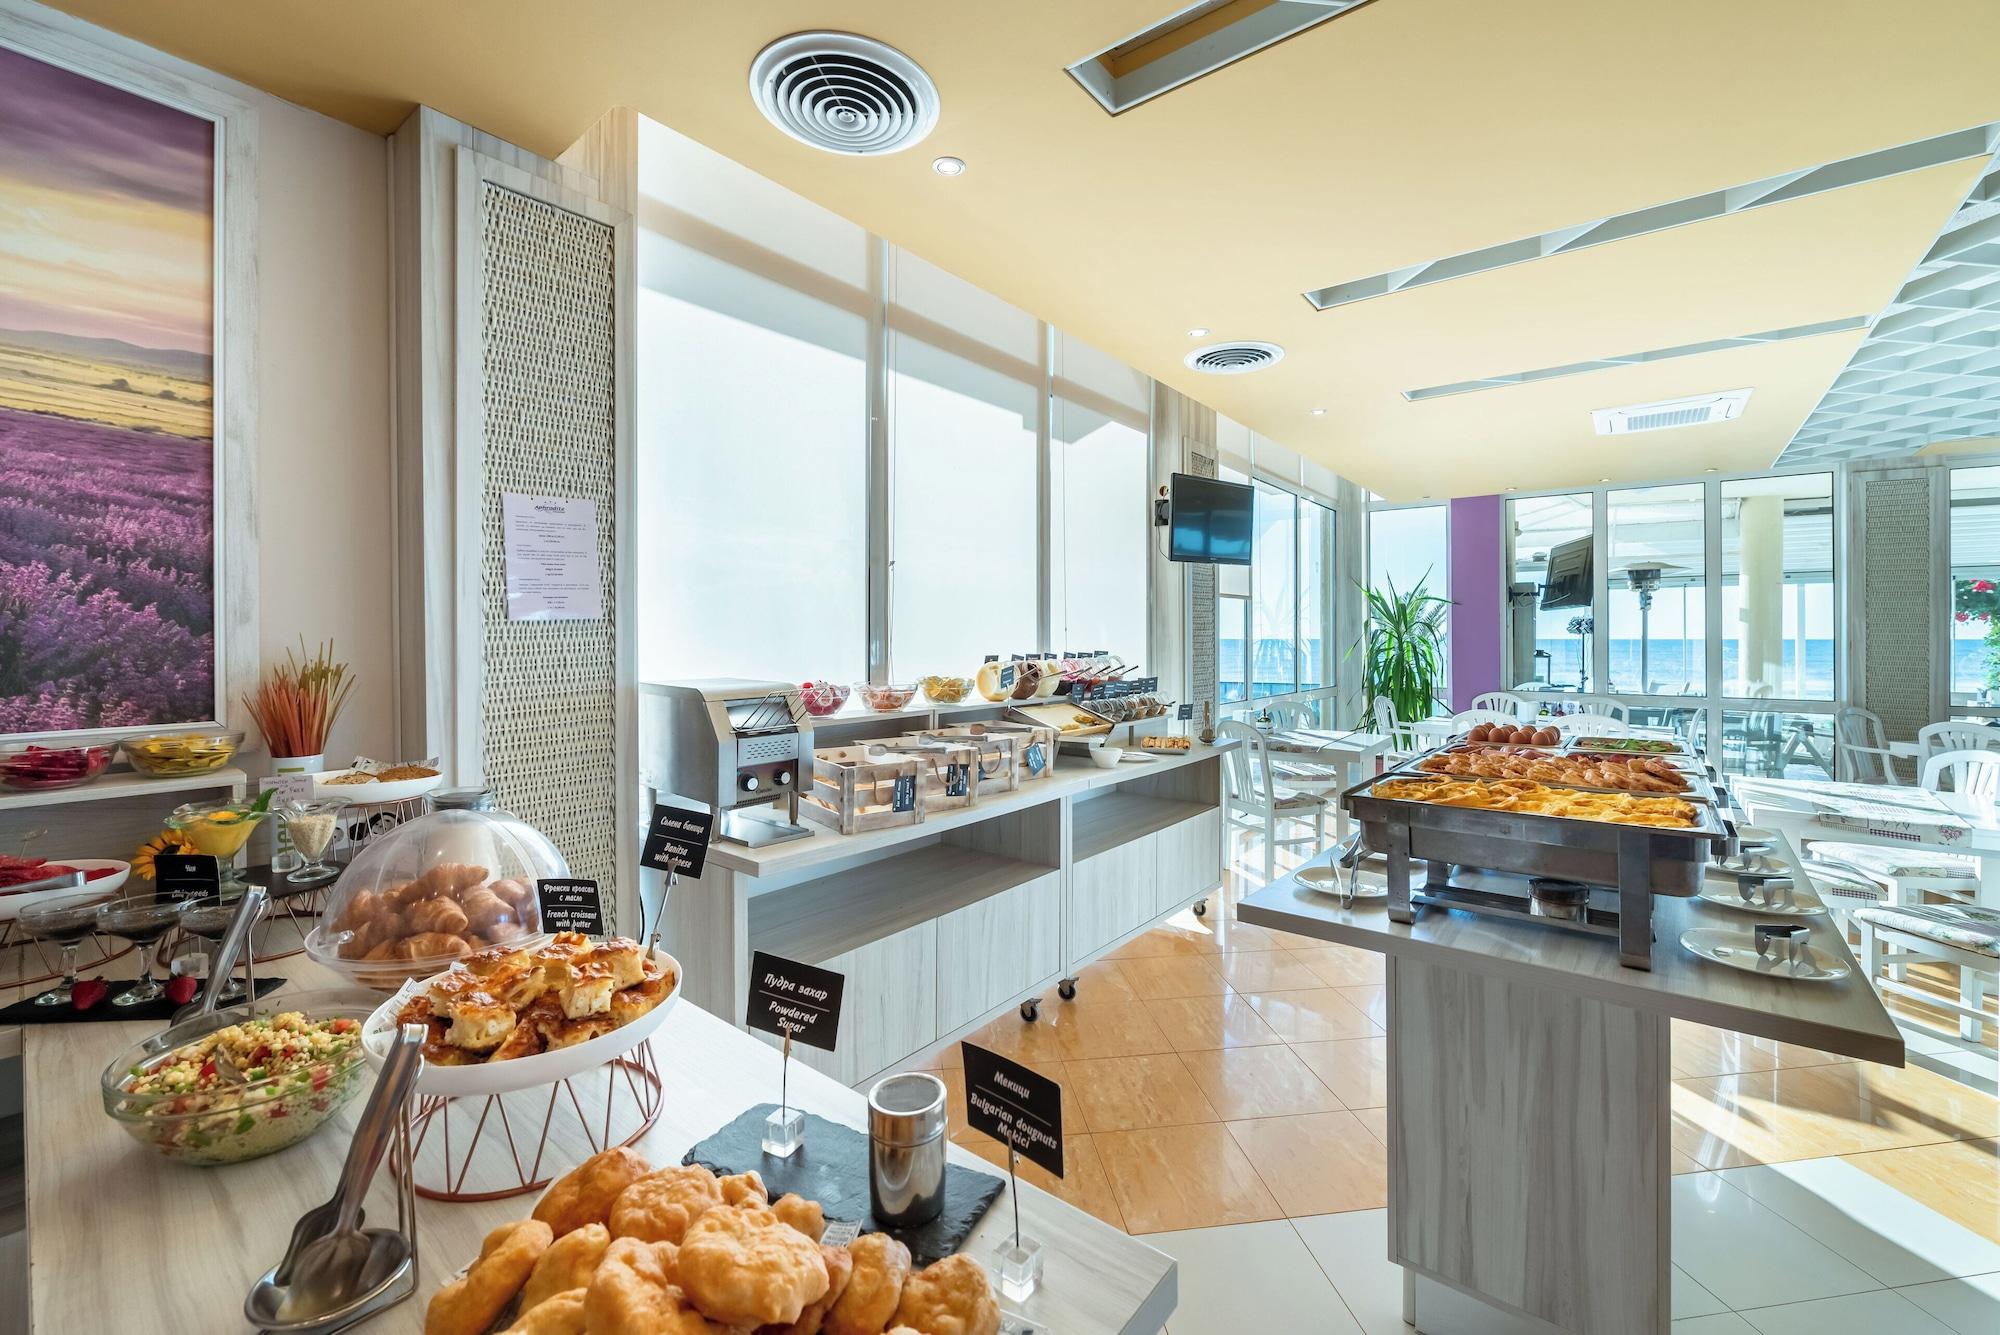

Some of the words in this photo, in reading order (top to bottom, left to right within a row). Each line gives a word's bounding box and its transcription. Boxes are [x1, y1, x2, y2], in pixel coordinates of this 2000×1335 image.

[661, 816, 682, 829] Солена
[664, 842, 688, 856] Banitsa
[654, 852, 669, 863] with
[543, 884, 570, 893] Френски
[572, 885, 595, 893] кроасан
[547, 909, 569, 918] French
[571, 910, 597, 919] croissant
[556, 919, 570, 927] with
[572, 919, 591, 928] butter
[764, 973, 796, 992] Пудра
[798, 985, 828, 1002] захар
[769, 1001, 818, 1024] Powdered
[993, 1071, 1031, 1099] Мекици
[970, 1092, 1013, 1124] Bulgarian
[1016, 1117, 1057, 1150] dougnuts
